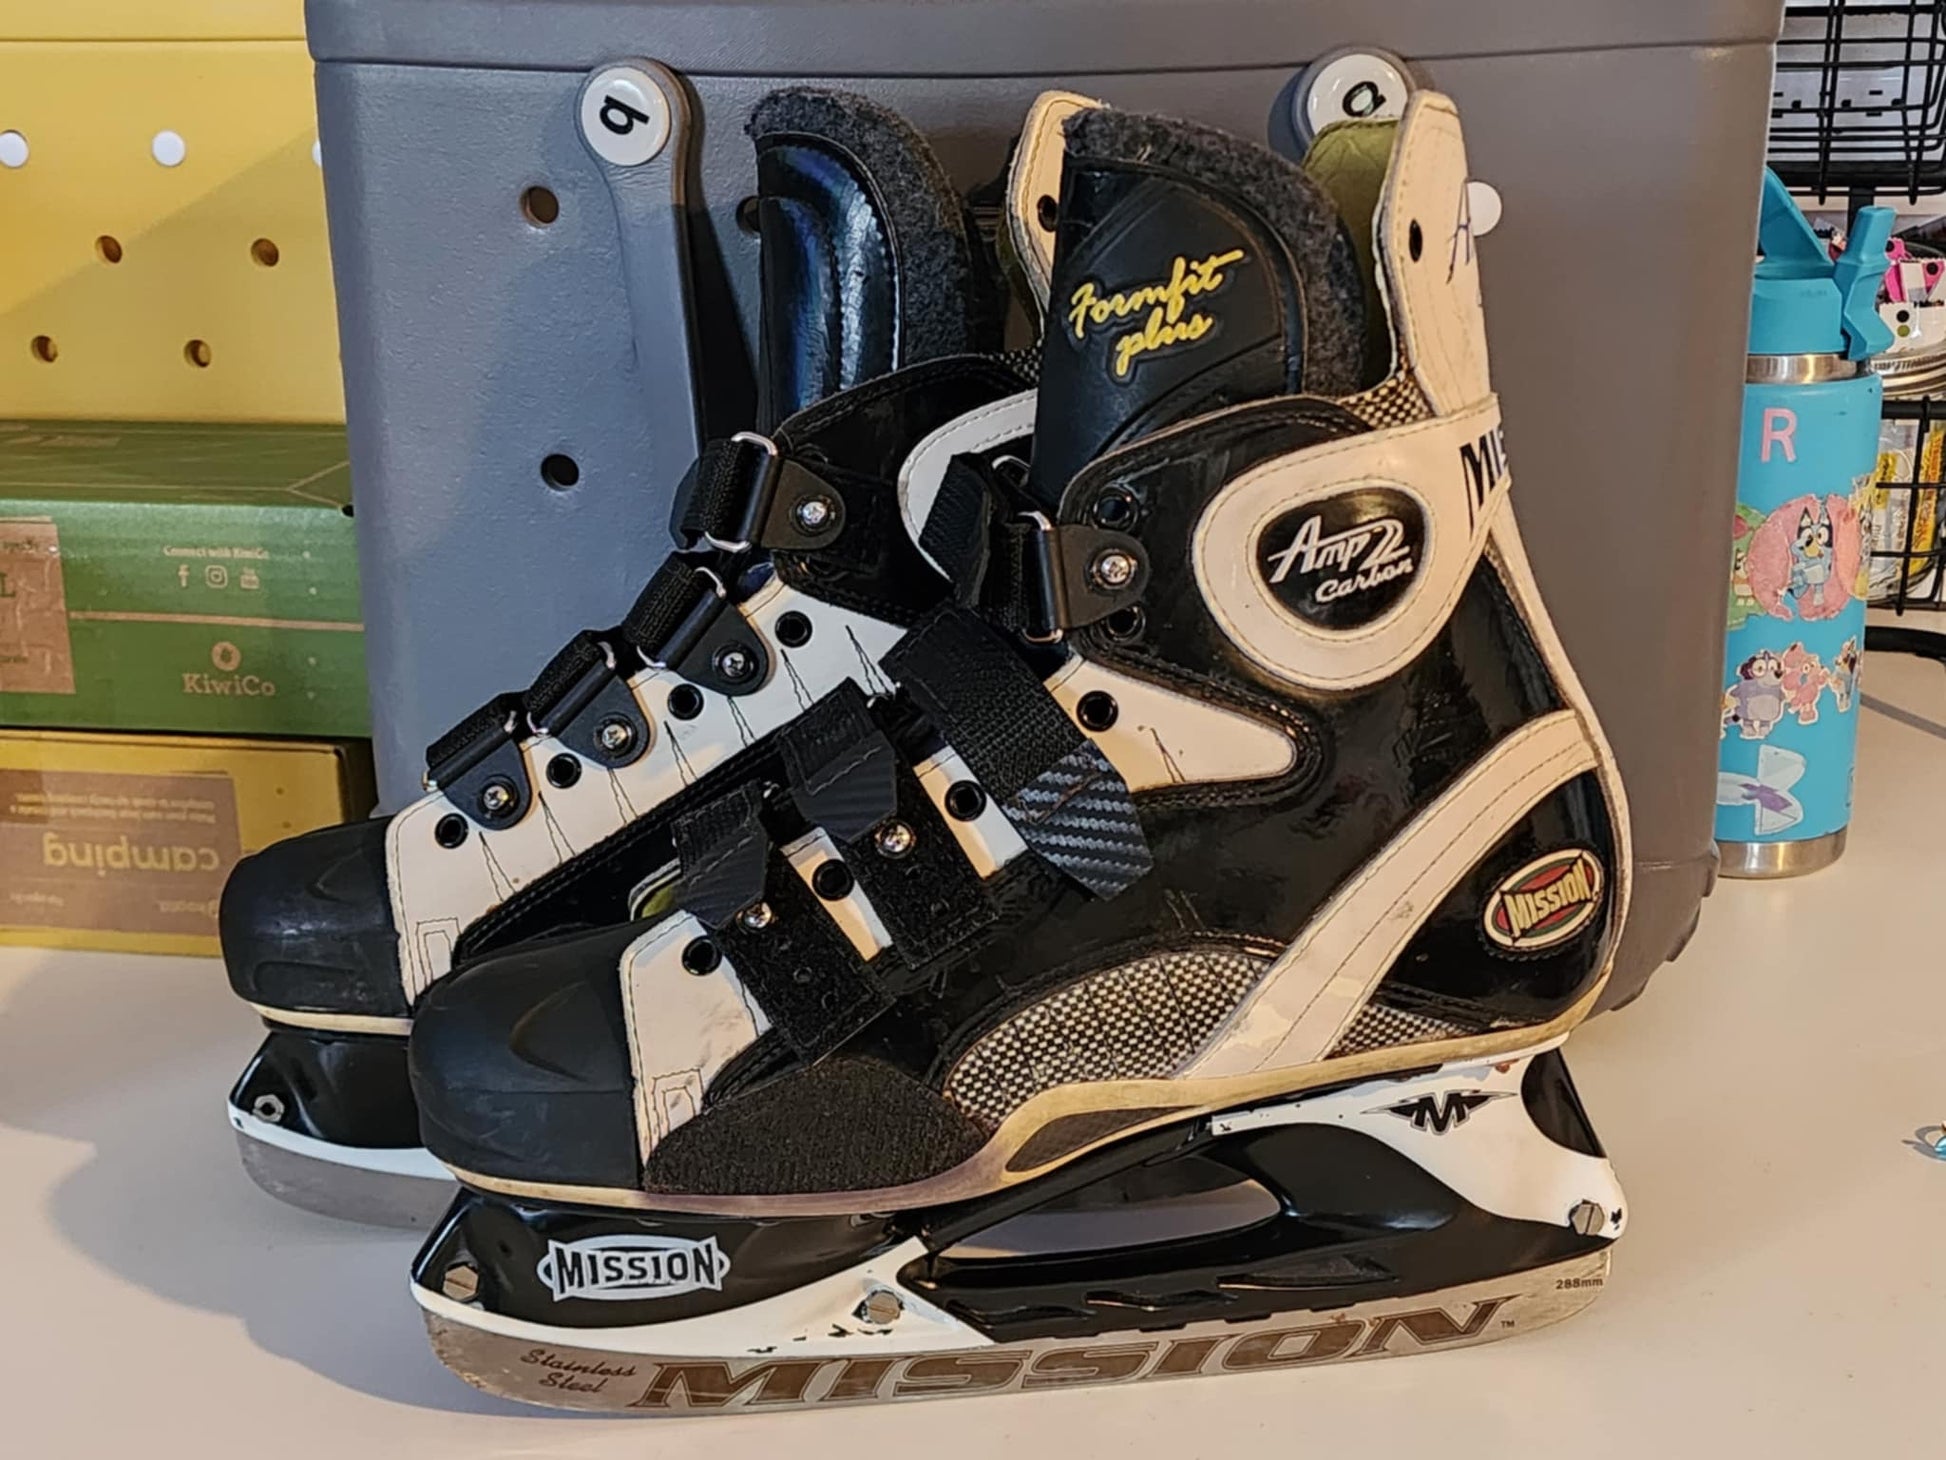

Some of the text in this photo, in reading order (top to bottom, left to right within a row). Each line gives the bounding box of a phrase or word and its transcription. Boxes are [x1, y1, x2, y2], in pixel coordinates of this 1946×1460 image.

[1068, 249, 1244, 339] Formfit
[1115, 307, 1213, 376] plus
[1761, 407, 1798, 463] R
[182, 672, 276, 697] KiwiCo
[42, 832, 221, 877] camping
[1503, 858, 1592, 938] MISSION
[553, 1242, 716, 1295] MISSION
[1555, 1277, 1604, 1291] 288mm
[520, 1348, 637, 1378] Stainless
[625, 1293, 1522, 1409] MISSION
[539, 1371, 609, 1394] Steel
